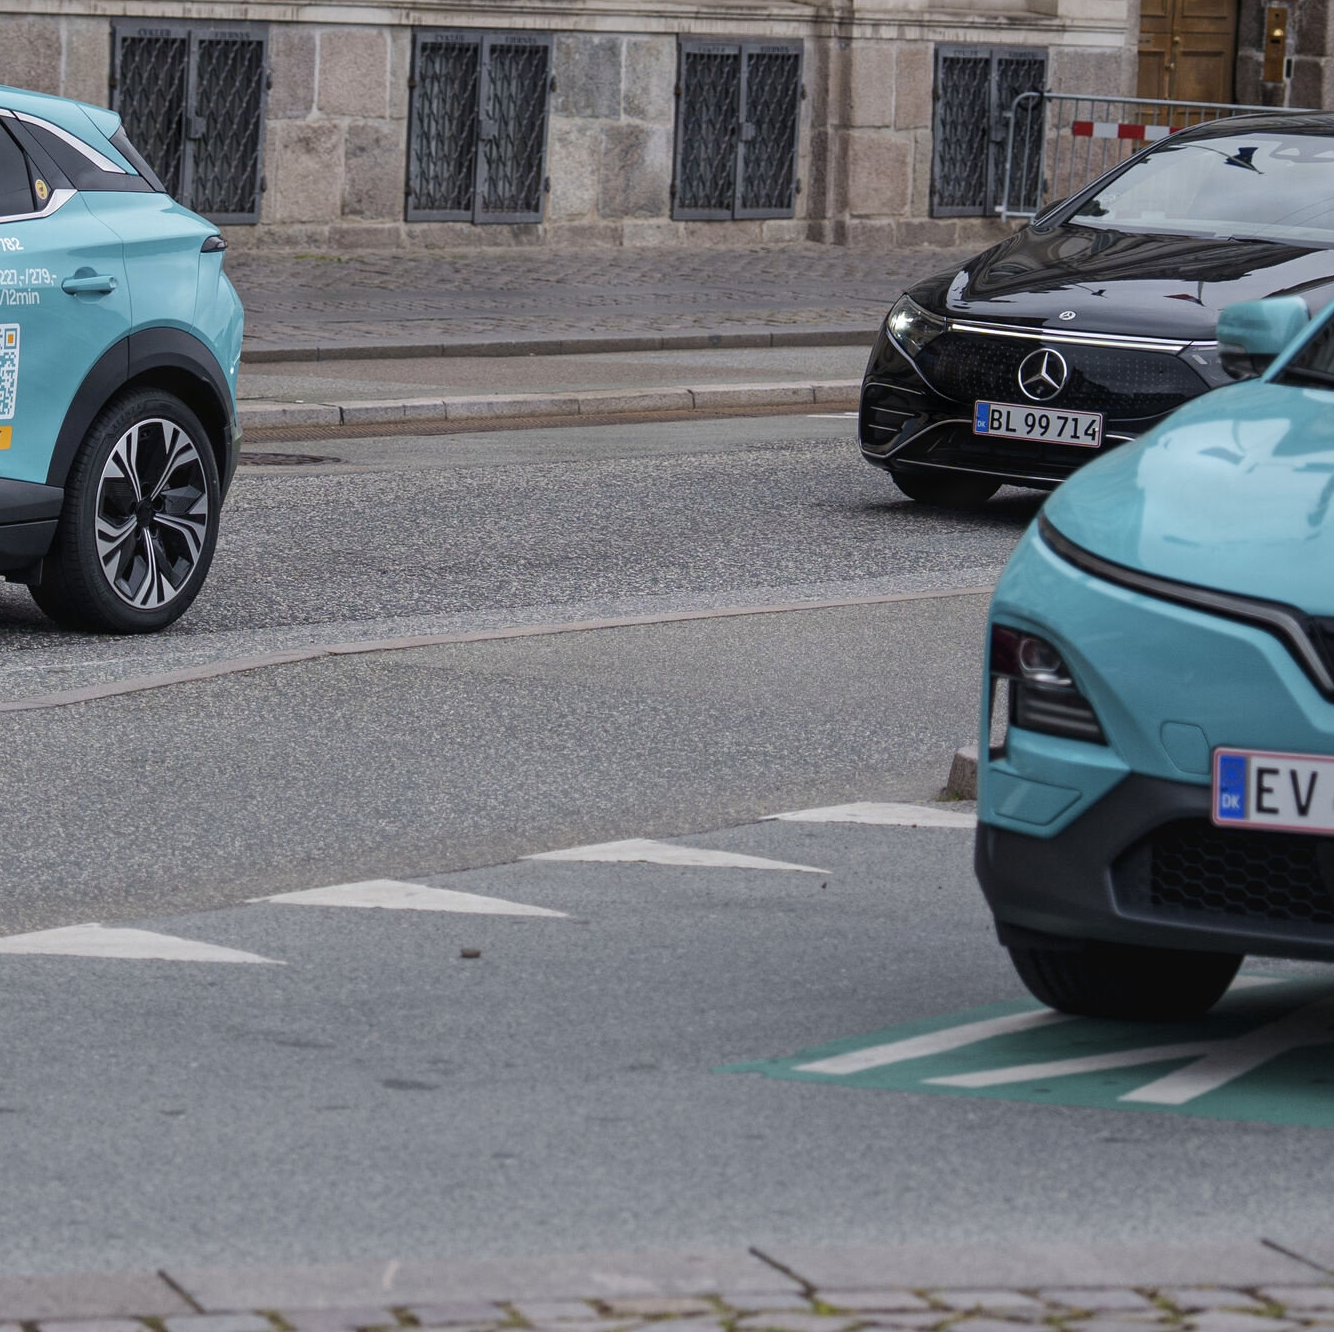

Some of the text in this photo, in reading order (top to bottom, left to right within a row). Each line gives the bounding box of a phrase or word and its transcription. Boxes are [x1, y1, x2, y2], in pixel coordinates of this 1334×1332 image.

[977, 419, 987, 428] DK
[989, 409, 1098, 441] BL 99 714
[1221, 793, 1240, 809] DK
[1255, 767, 1318, 817] EV
